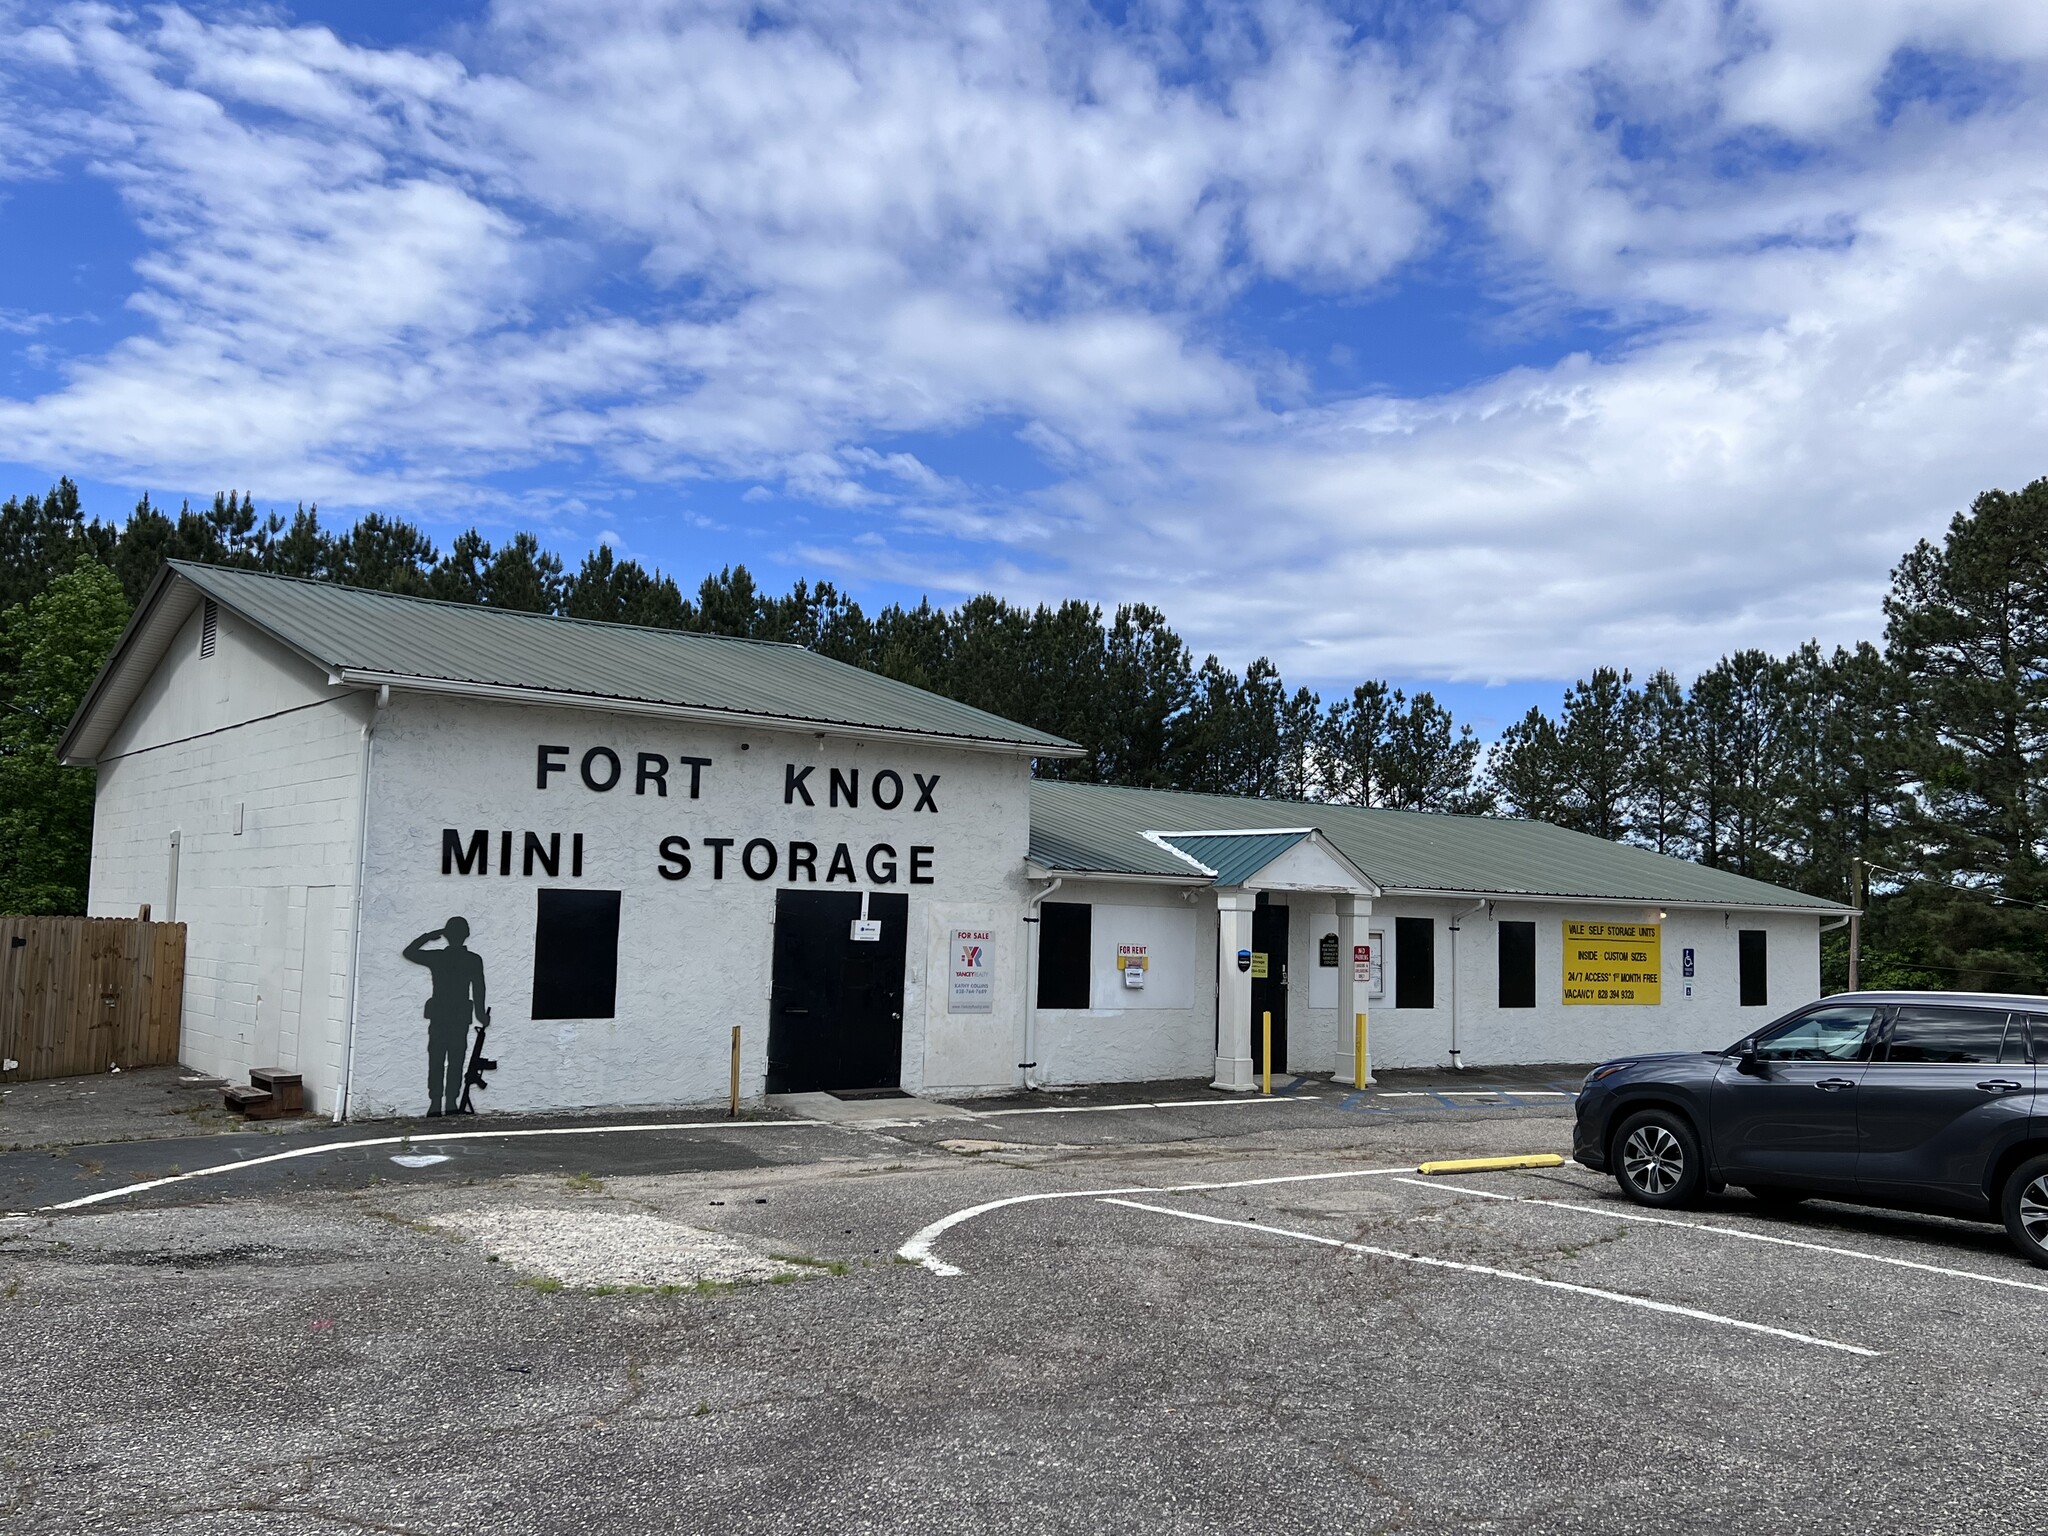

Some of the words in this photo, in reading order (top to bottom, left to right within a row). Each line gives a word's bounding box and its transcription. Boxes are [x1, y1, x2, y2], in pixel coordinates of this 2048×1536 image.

[536, 744, 713, 800] FORT
[784, 763, 941, 814] KNOX
[441, 828, 584, 878] MINI
[657, 835, 936, 886] STORAGE
[1568, 925, 1585, 935] VALE
[1588, 925, 1604, 935] SELF
[1607, 926, 1636, 937] STORAGE
[1638, 927, 1656, 937] UNITS
[1120, 946, 1130, 954] FOR
[1578, 951, 1598, 960] INSIDE
[1604, 952, 1628, 961] CUSTOM
[1631, 952, 1647, 962] SIZES
[1567, 971, 1583, 982] 24/7
[1621, 973, 1641, 983] MONTH
[1643, 974, 1658, 983] FREE
[1564, 989, 1595, 999] VACANCY
[1597, 989, 1608, 999] 828
[1609, 989, 1620, 999] 394
[1620, 990, 1634, 1000] 9328
